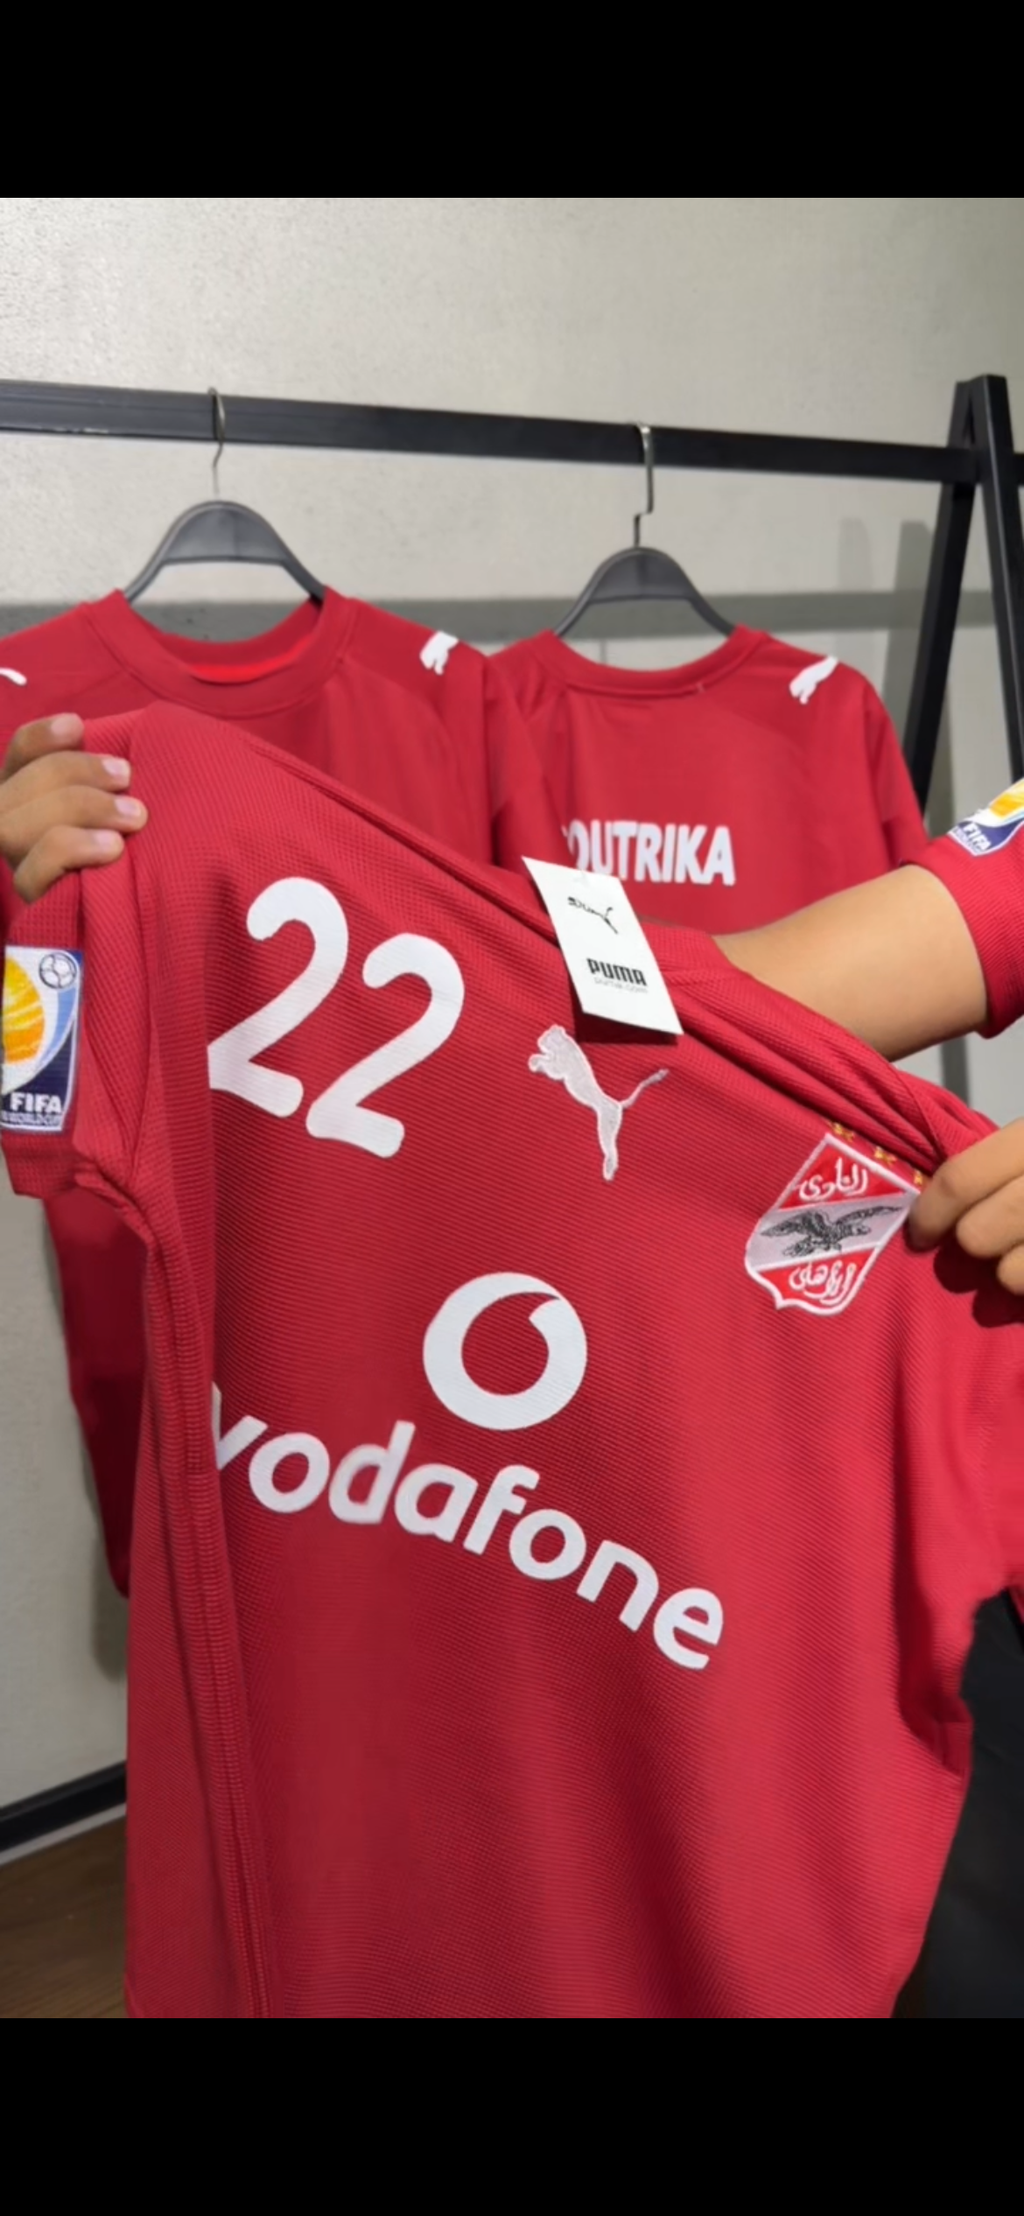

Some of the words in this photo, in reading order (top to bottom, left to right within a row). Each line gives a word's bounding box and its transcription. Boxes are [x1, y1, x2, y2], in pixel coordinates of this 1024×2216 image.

[561, 819, 737, 886] OUTRIKA
[586, 957, 648, 987] PUMA
[207, 876, 465, 1158] 22
[10, 1091, 62, 1113] FIFA
[211, 1380, 724, 1670] vodafone
